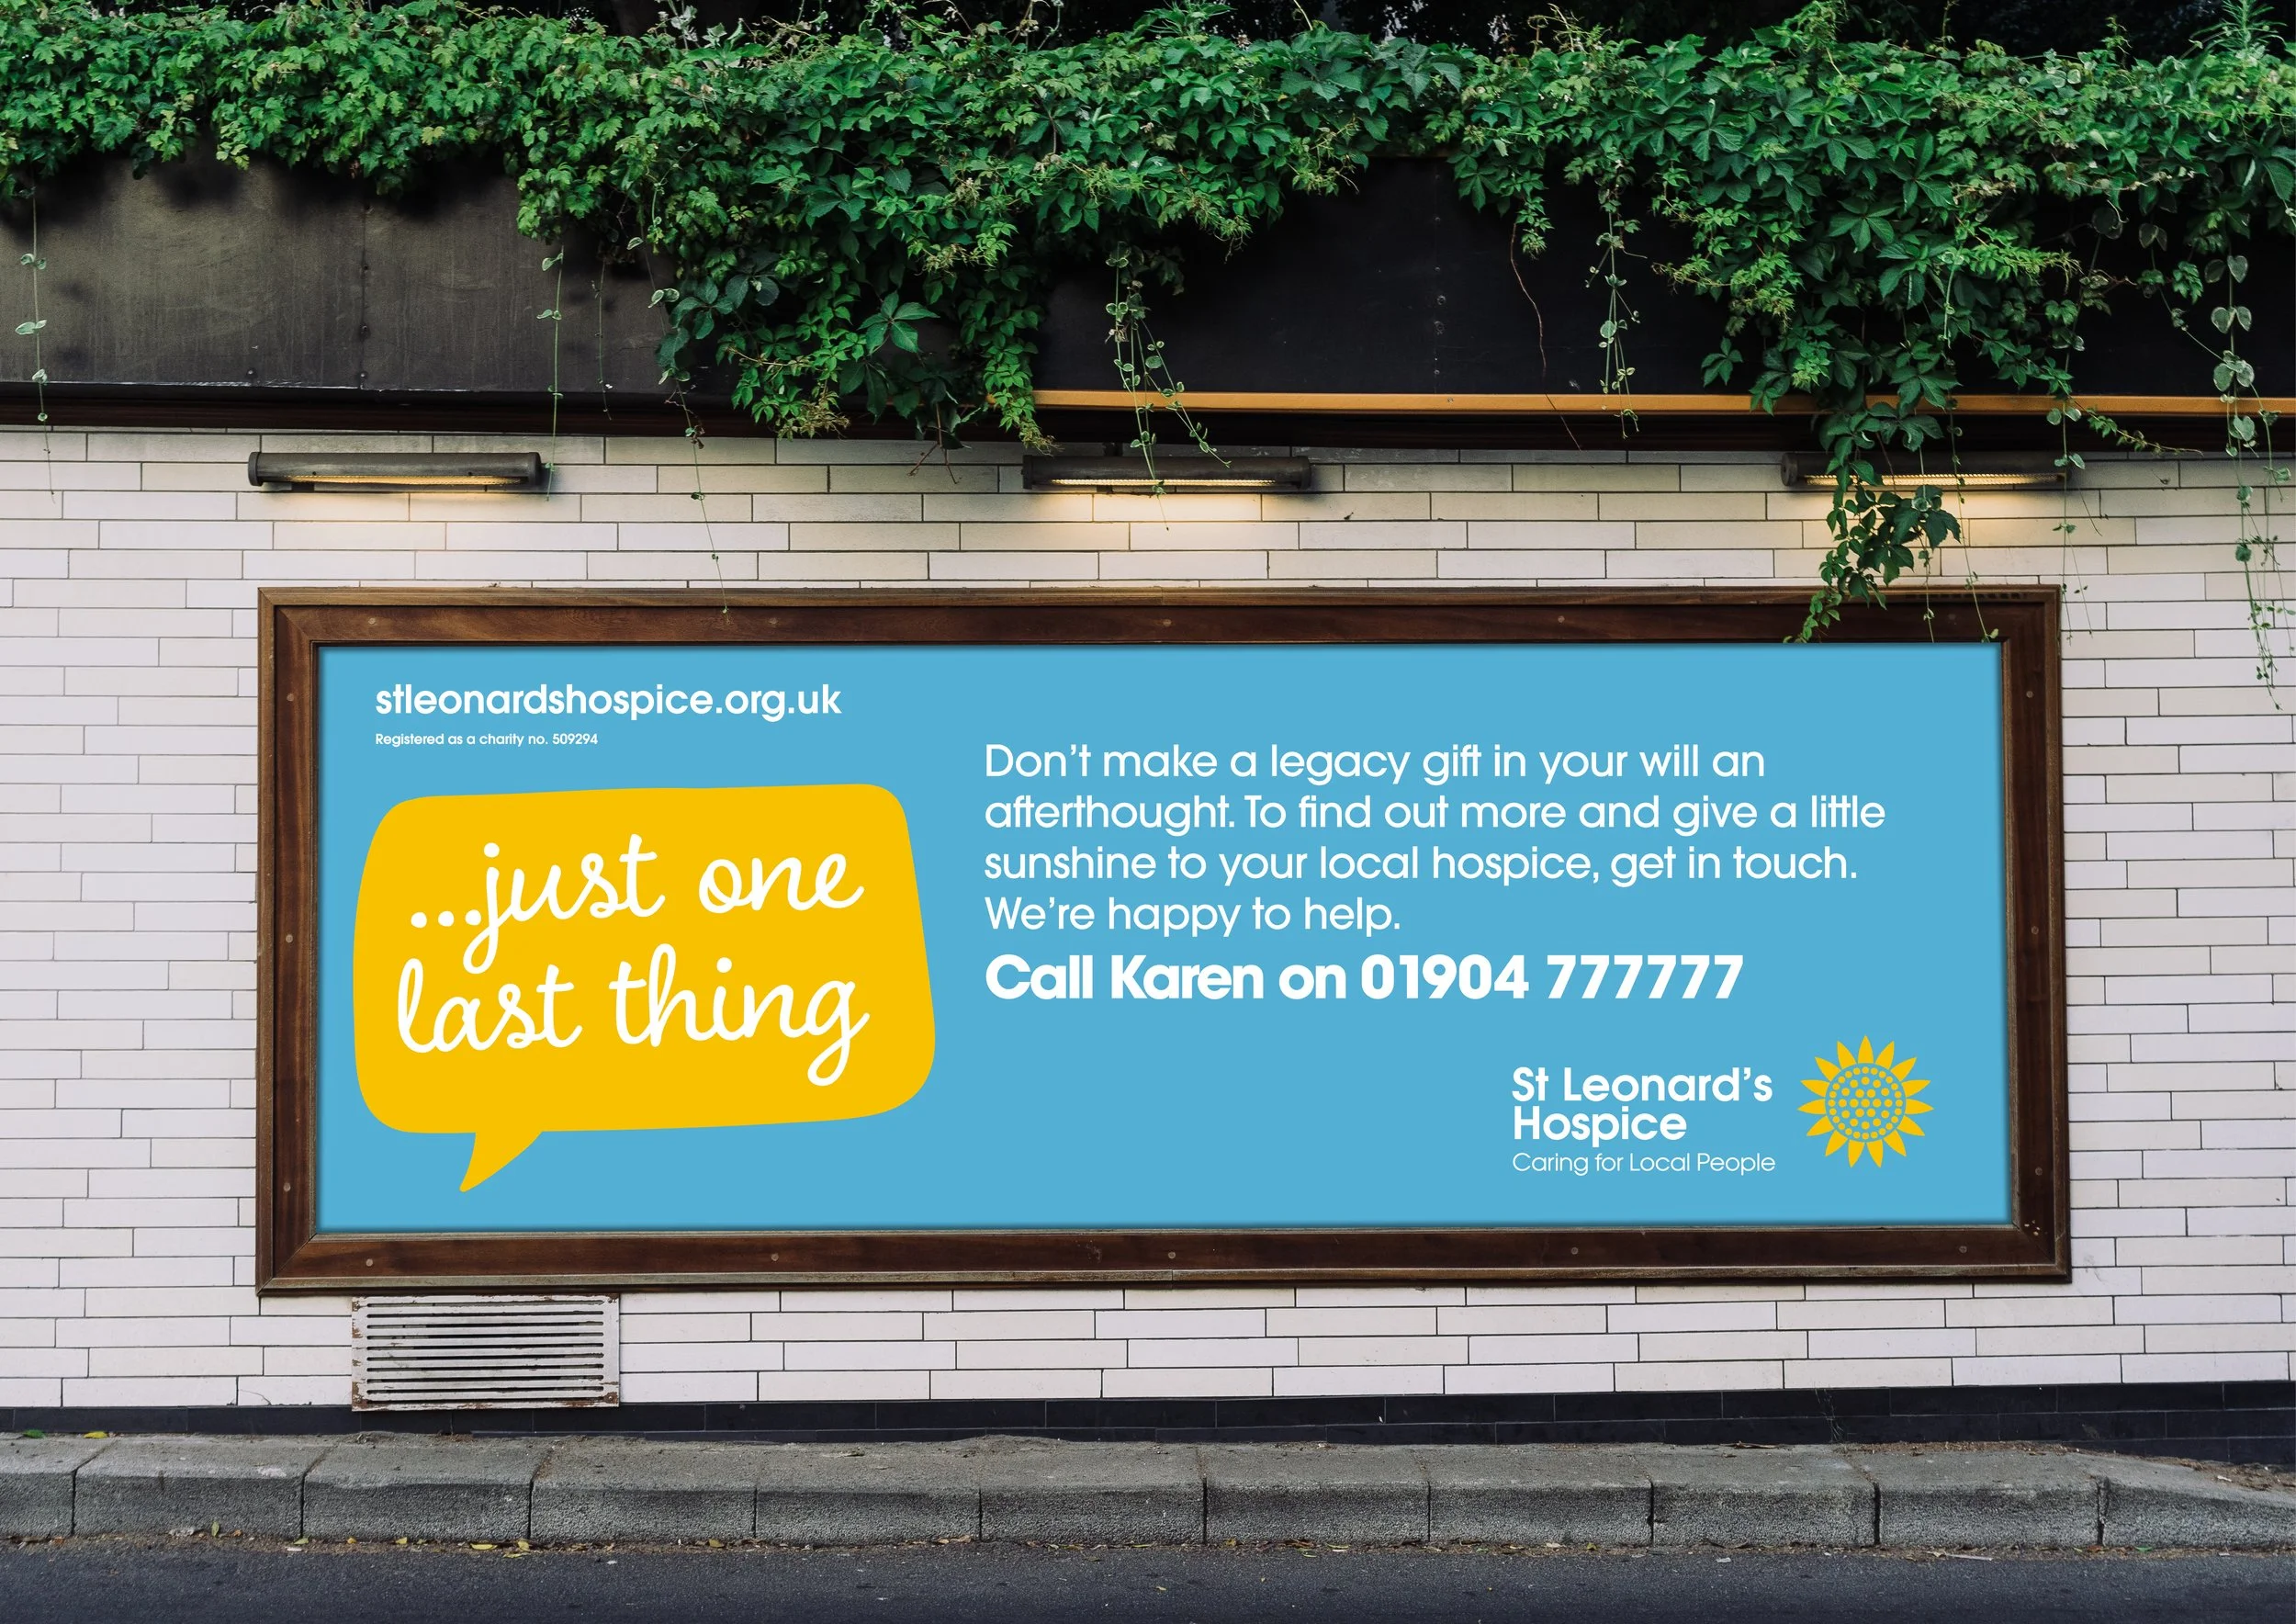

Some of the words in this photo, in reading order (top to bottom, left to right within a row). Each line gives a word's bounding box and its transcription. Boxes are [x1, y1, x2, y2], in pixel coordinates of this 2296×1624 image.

[376, 684, 842, 722] stleonardshospice.org.uk
[376, 734, 444, 747] Registered
[447, 736, 464, 745] as
[467, 736, 476, 745] a
[479, 734, 524, 747] charity
[528, 736, 548, 745] no.
[552, 734, 599, 745] 509294
[986, 744, 1091, 777] Don’t
[1104, 744, 1217, 777] make
[1231, 751, 1256, 777] a
[1272, 744, 1411, 785] legacy
[1423, 744, 1481, 785] gift
[1495, 744, 1525, 776] in
[1539, 751, 1627, 784] your
[1639, 744, 1698, 776] will
[1713, 751, 1764, 777] an
[985, 795, 1234, 836] afterthought.
[1244, 795, 1286, 828] To
[1299, 795, 1370, 828] find
[1385, 795, 1448, 828] out
[1462, 803, 1566, 828] more
[1580, 795, 1659, 828] and
[1673, 795, 1757, 836] give
[1771, 803, 1795, 828] a
[1812, 795, 1885, 828] little
[698, 853, 865, 913] one
[985, 846, 1156, 879] sunshine
[1168, 846, 1206, 878] to
[1220, 853, 1308, 885] your
[1321, 846, 1418, 879] local
[1434, 846, 1598, 885] hospice,
[1611, 846, 1676, 887] get
[1689, 846, 1720, 878] in
[1733, 846, 1856, 879] touch.
[985, 897, 1095, 930] We’re
[1109, 897, 1241, 937] happy
[1253, 897, 1290, 930] to
[1305, 897, 1400, 937] help.
[986, 954, 1093, 999] Call
[1111, 955, 1264, 999] Karen
[1279, 964, 1346, 999] on
[1362, 954, 1529, 999] 01904
[1548, 955, 1743, 998] 777777
[398, 958, 583, 1054] last
[608, 943, 871, 1087] thing
[1512, 1067, 1549, 1102] St
[1564, 1067, 1773, 1102] Leonard’s
[1514, 1106, 1687, 1148] Hospice
[1513, 1153, 1589, 1176] Caring
[1594, 1153, 1624, 1172] for
[1629, 1153, 1691, 1172] Local
[1697, 1153, 1776, 1176] People
